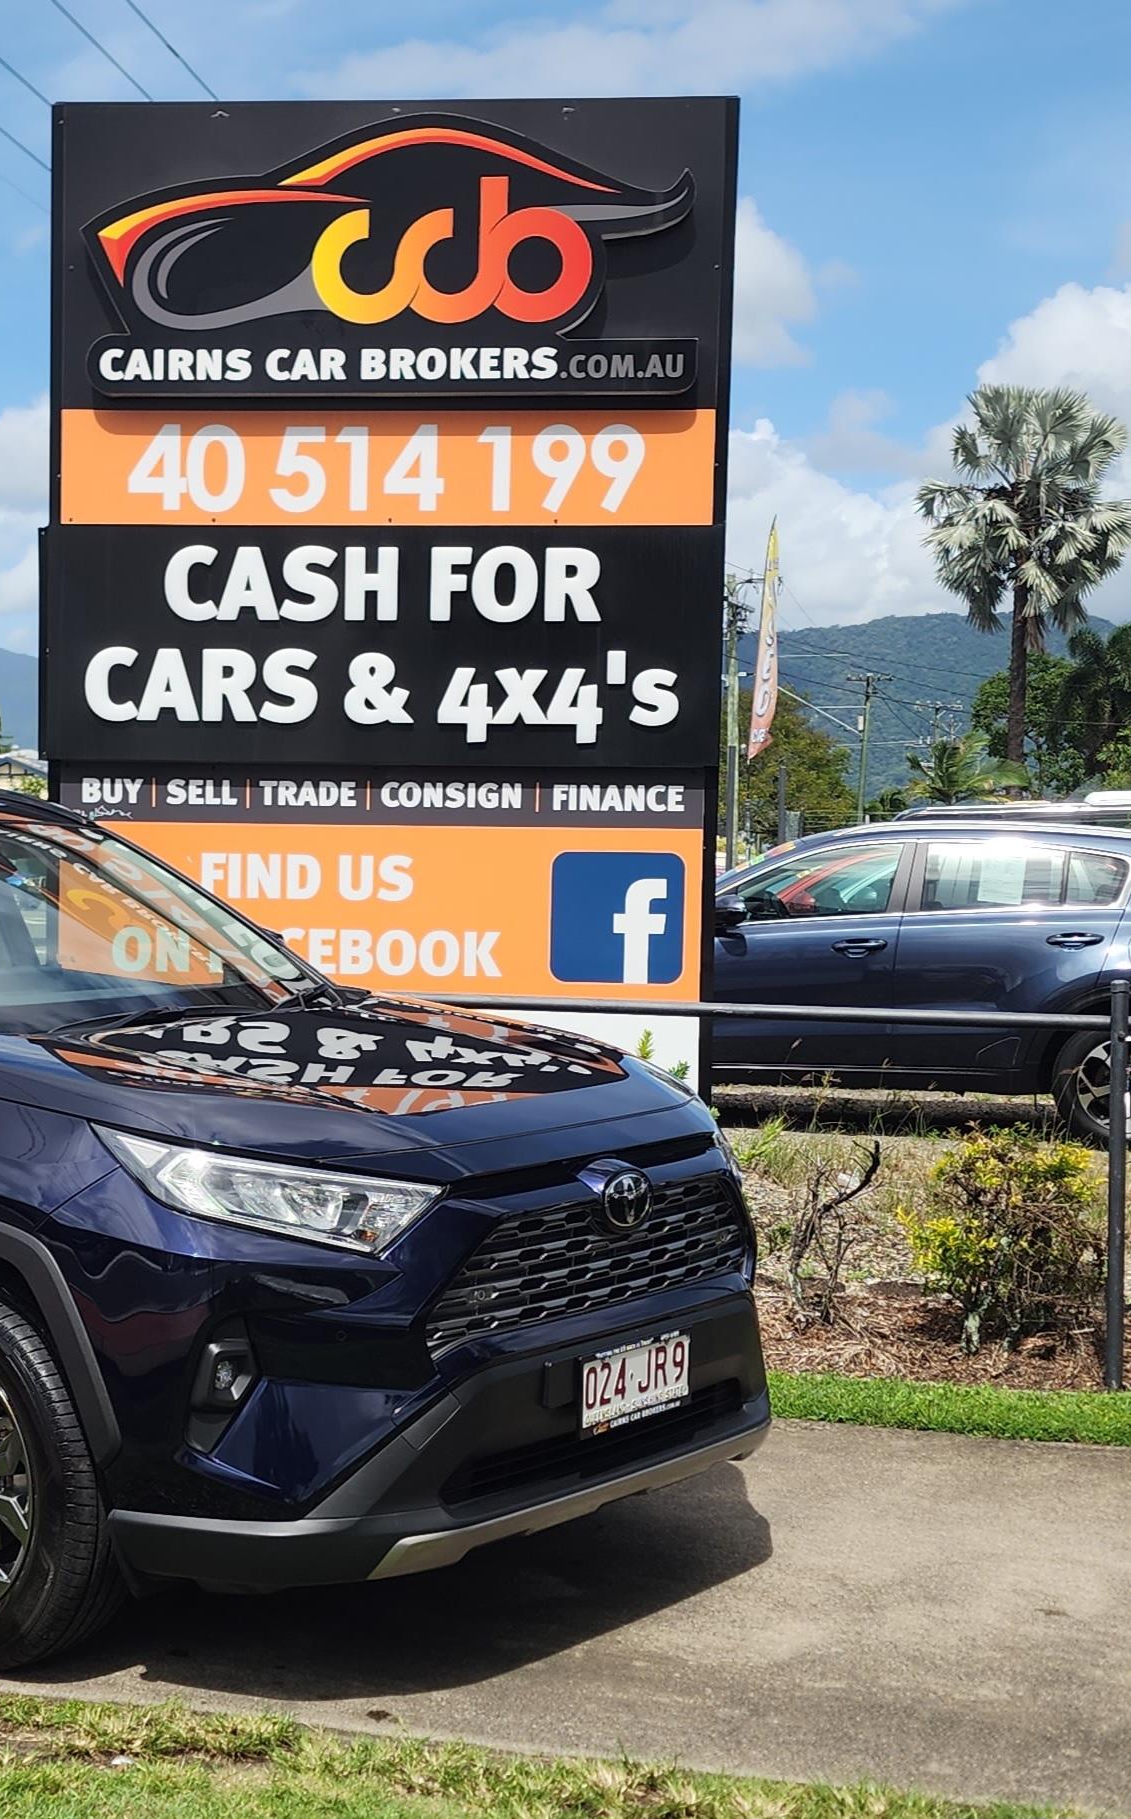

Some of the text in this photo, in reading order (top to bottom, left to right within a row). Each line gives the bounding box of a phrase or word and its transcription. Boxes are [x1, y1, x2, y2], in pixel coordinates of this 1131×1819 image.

[99, 348, 252, 381] CAIRNS
[265, 348, 347, 381] CAR
[127, 424, 646, 514] 40 514 199
[164, 544, 601, 623] CASH FOR
[84, 646, 318, 725] CARS
[344, 652, 414, 725] &
[81, 777, 685, 812] BUY SELL TRADE CONSIGN FINANCE
[200, 852, 414, 902] FIND US
[112, 926, 191, 973] ON
